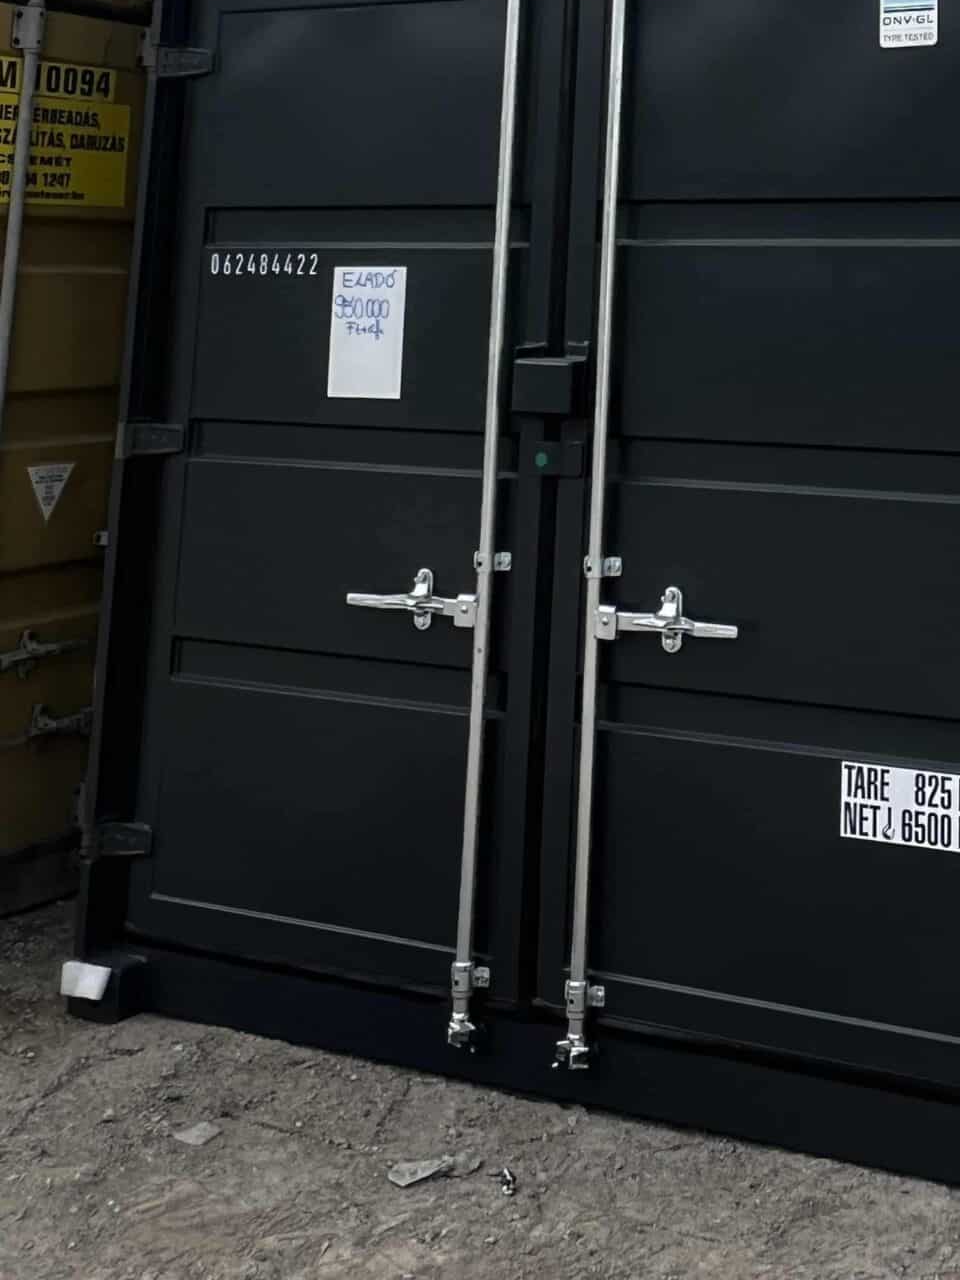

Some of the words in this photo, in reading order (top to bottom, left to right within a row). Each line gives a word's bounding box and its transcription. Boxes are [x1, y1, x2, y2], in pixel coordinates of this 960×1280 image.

[210, 253, 319, 275] 062484422
[844, 764, 890, 802] TARE
[914, 773, 952, 810] 825
[844, 801, 881, 838] NET
[901, 809, 952, 848] 6500
